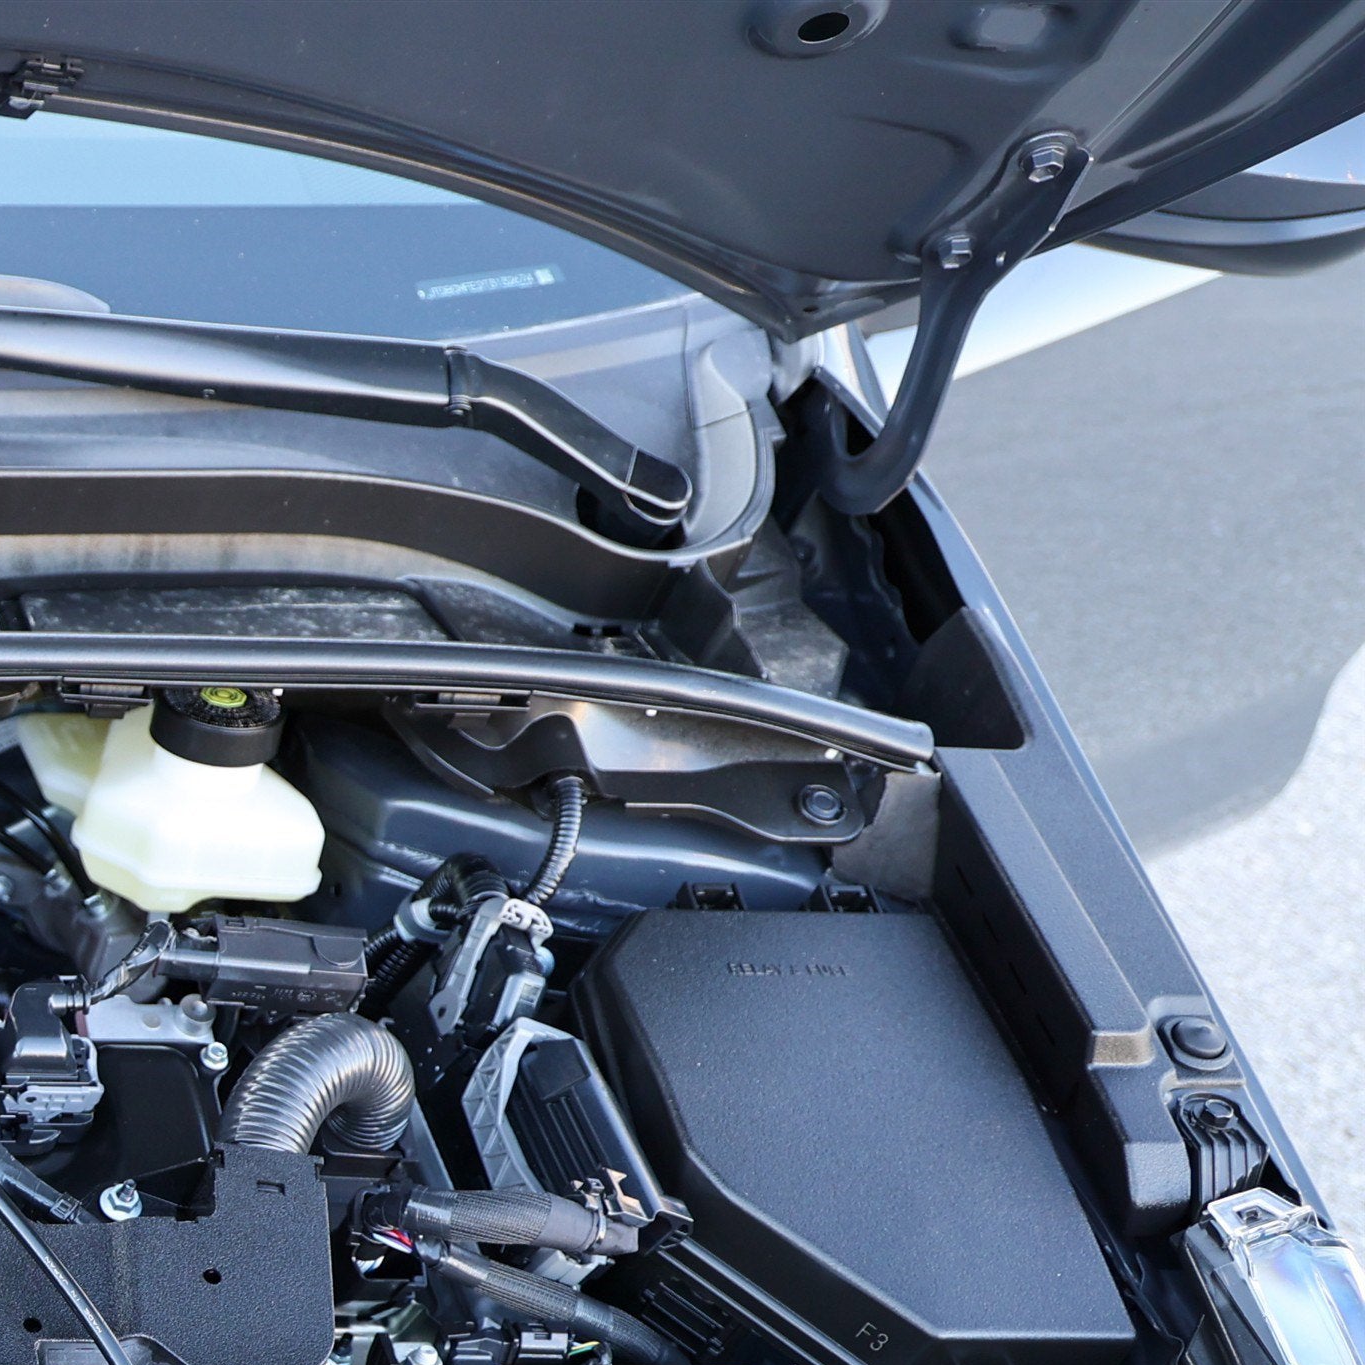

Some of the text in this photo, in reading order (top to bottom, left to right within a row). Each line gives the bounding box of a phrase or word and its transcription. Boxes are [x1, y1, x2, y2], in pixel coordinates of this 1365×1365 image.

[44, 1254, 69, 1287] JAPAN
[82, 1307, 104, 1334] MADE
[854, 1323, 889, 1352] F3
